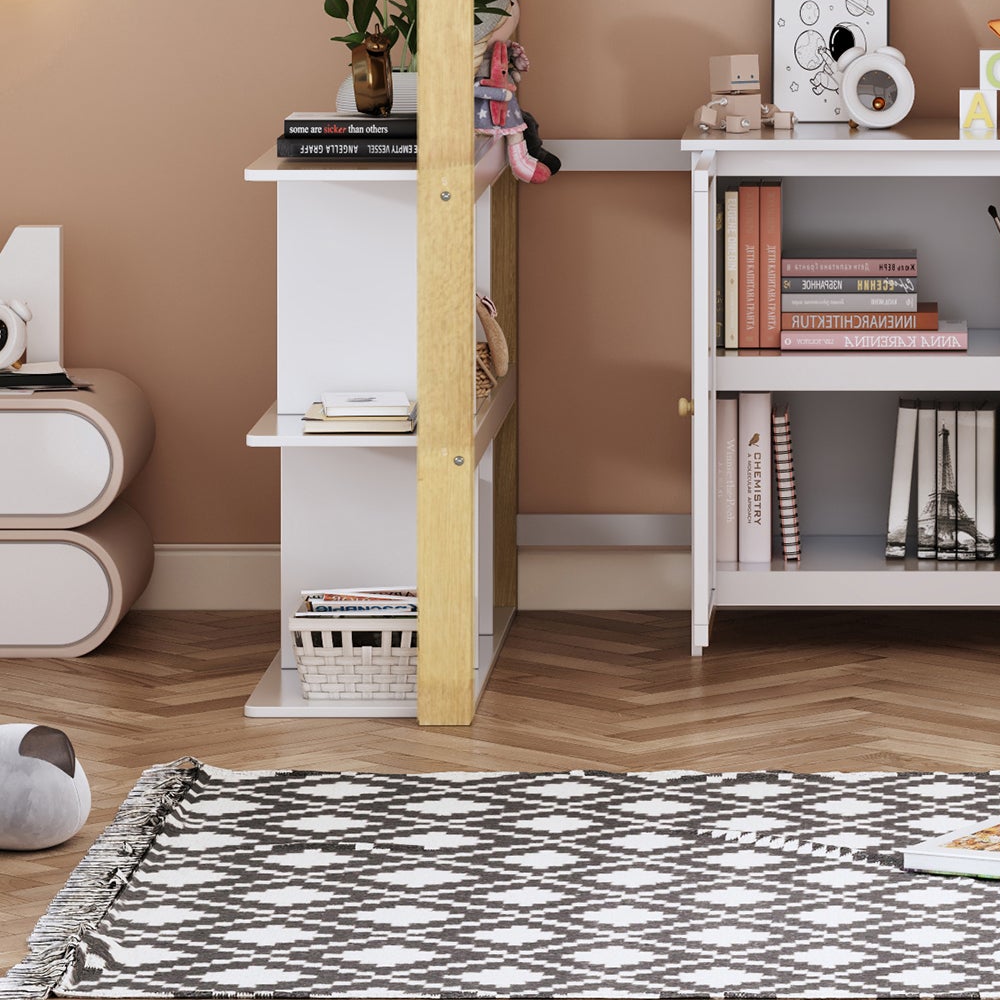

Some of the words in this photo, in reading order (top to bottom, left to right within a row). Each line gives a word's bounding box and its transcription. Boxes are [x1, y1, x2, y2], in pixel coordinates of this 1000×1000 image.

[963, 91, 995, 129] A
[288, 125, 309, 134] some
[310, 125, 322, 134] are
[323, 124, 346, 134] sicker
[348, 124, 364, 134] than
[365, 124, 388, 134] others
[300, 145, 323, 154] GRAFF
[326, 145, 359, 154] ANGELLA
[368, 145, 390, 154] VESSEL
[392, 145, 413, 154] EMPTY
[754, 452, 762, 526] CHEMISTRY
